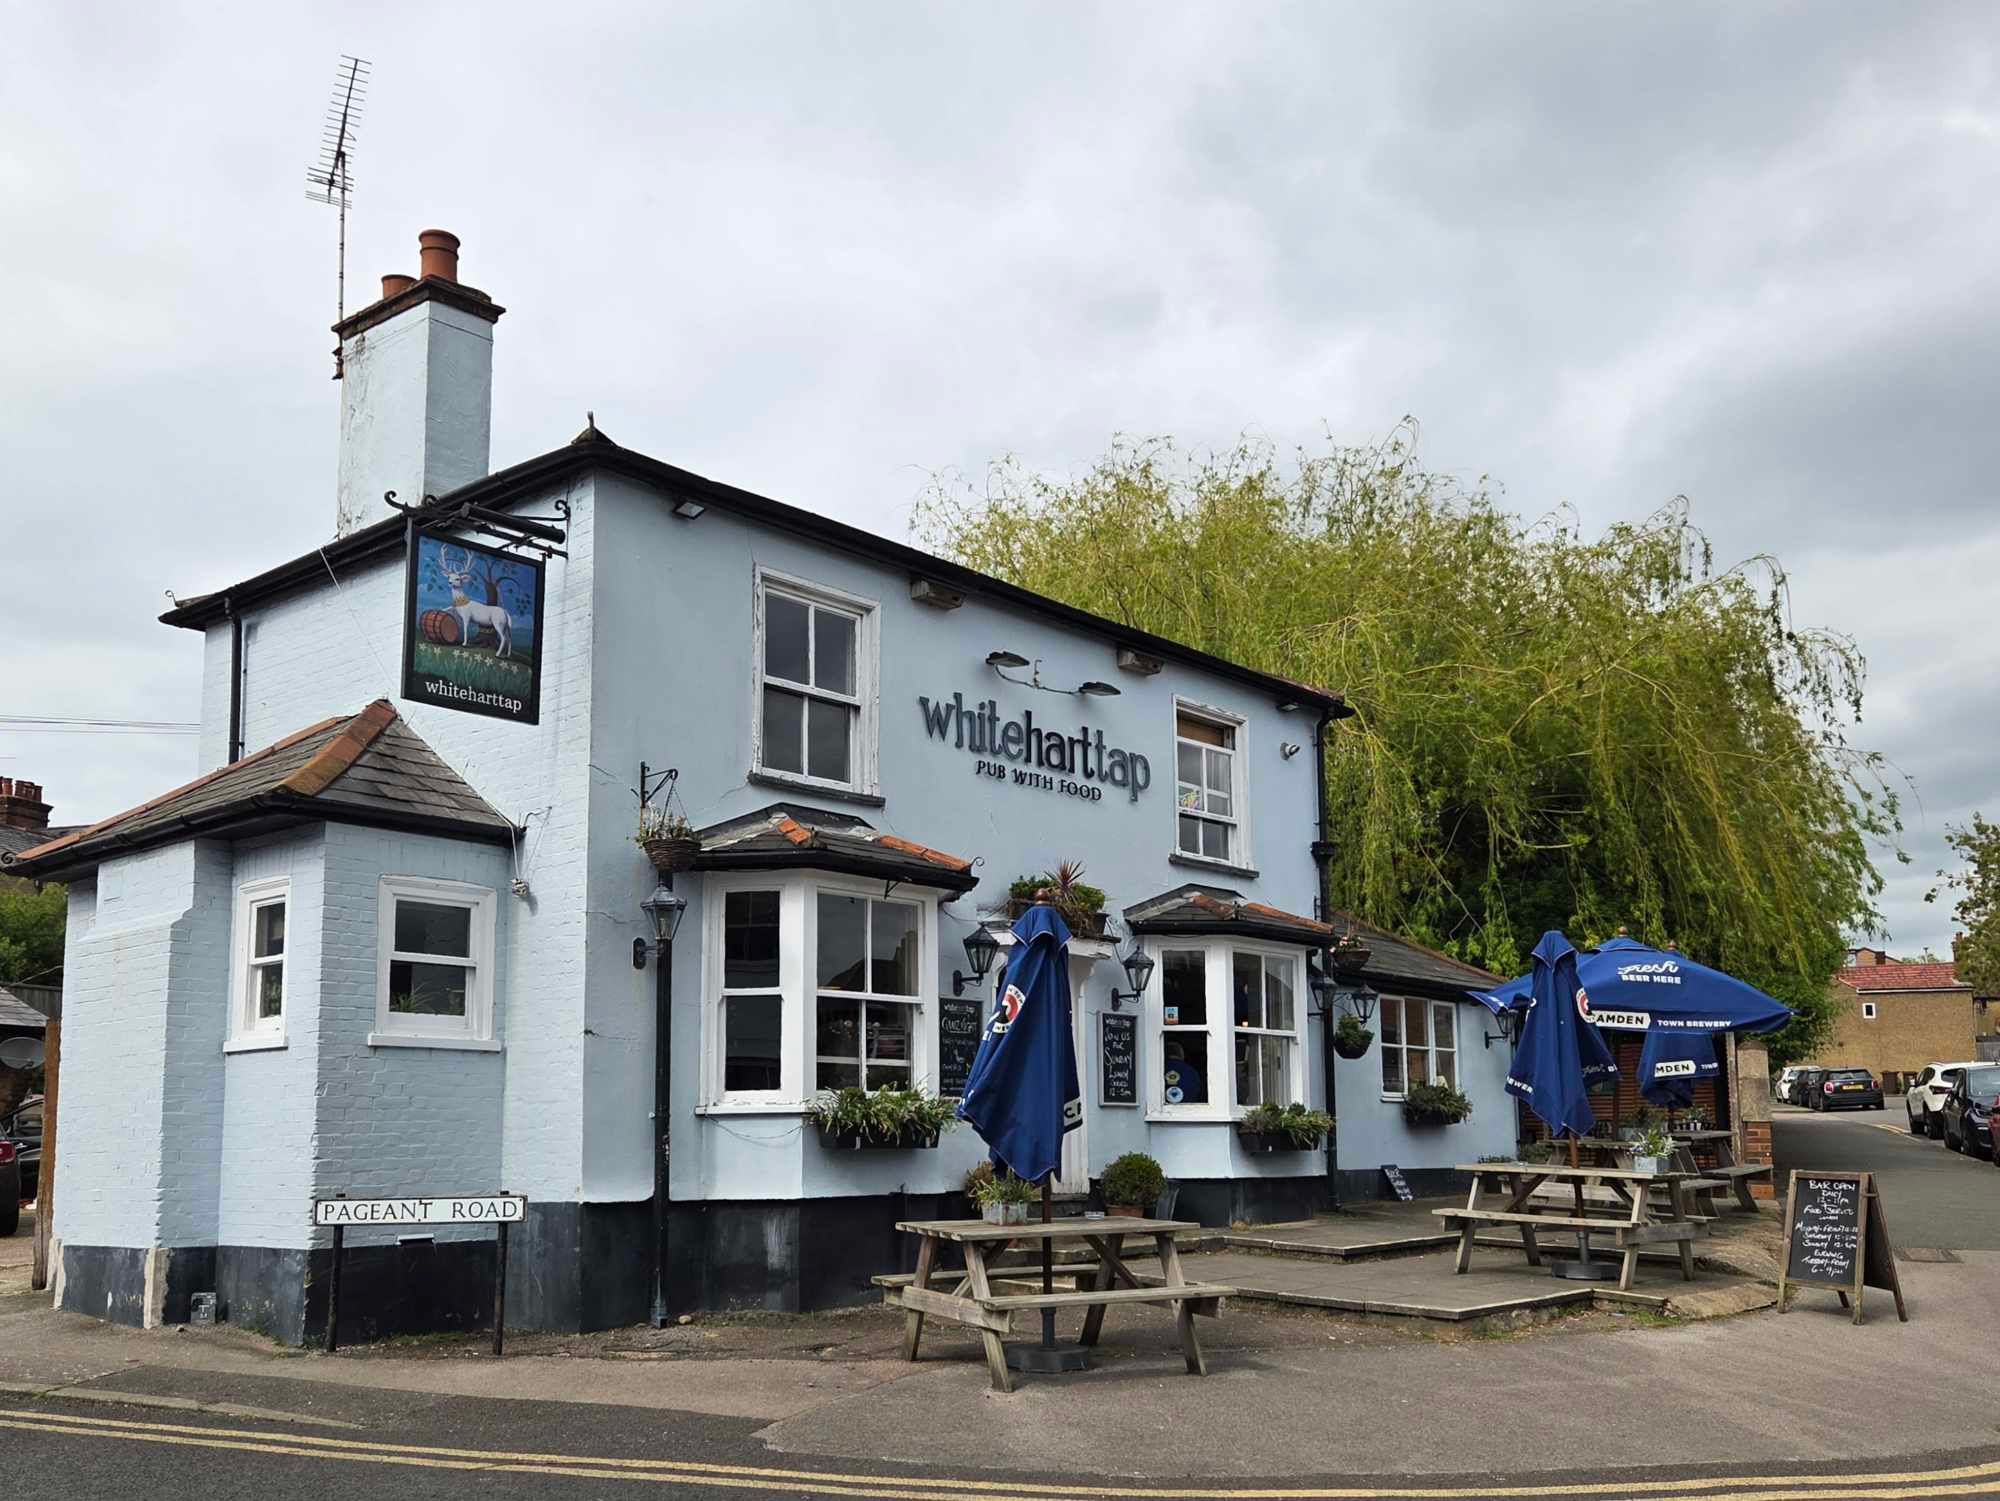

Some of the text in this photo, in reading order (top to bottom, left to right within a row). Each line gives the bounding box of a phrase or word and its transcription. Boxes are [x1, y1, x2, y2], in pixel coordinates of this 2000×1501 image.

[424, 679, 522, 714] whiteharttap
[918, 691, 1151, 802] whiteharttap
[975, 759, 1103, 801] PUB WITH FOOD
[1621, 974, 1682, 985] BEER HERE
[1595, 1013, 1732, 1028] AMDEN TOWN BREWERY
[1655, 1063, 1690, 1074] MDEN
[1808, 1179, 1856, 1191] BAR OPEN
[323, 1200, 518, 1221] PAGEANT ROAD
